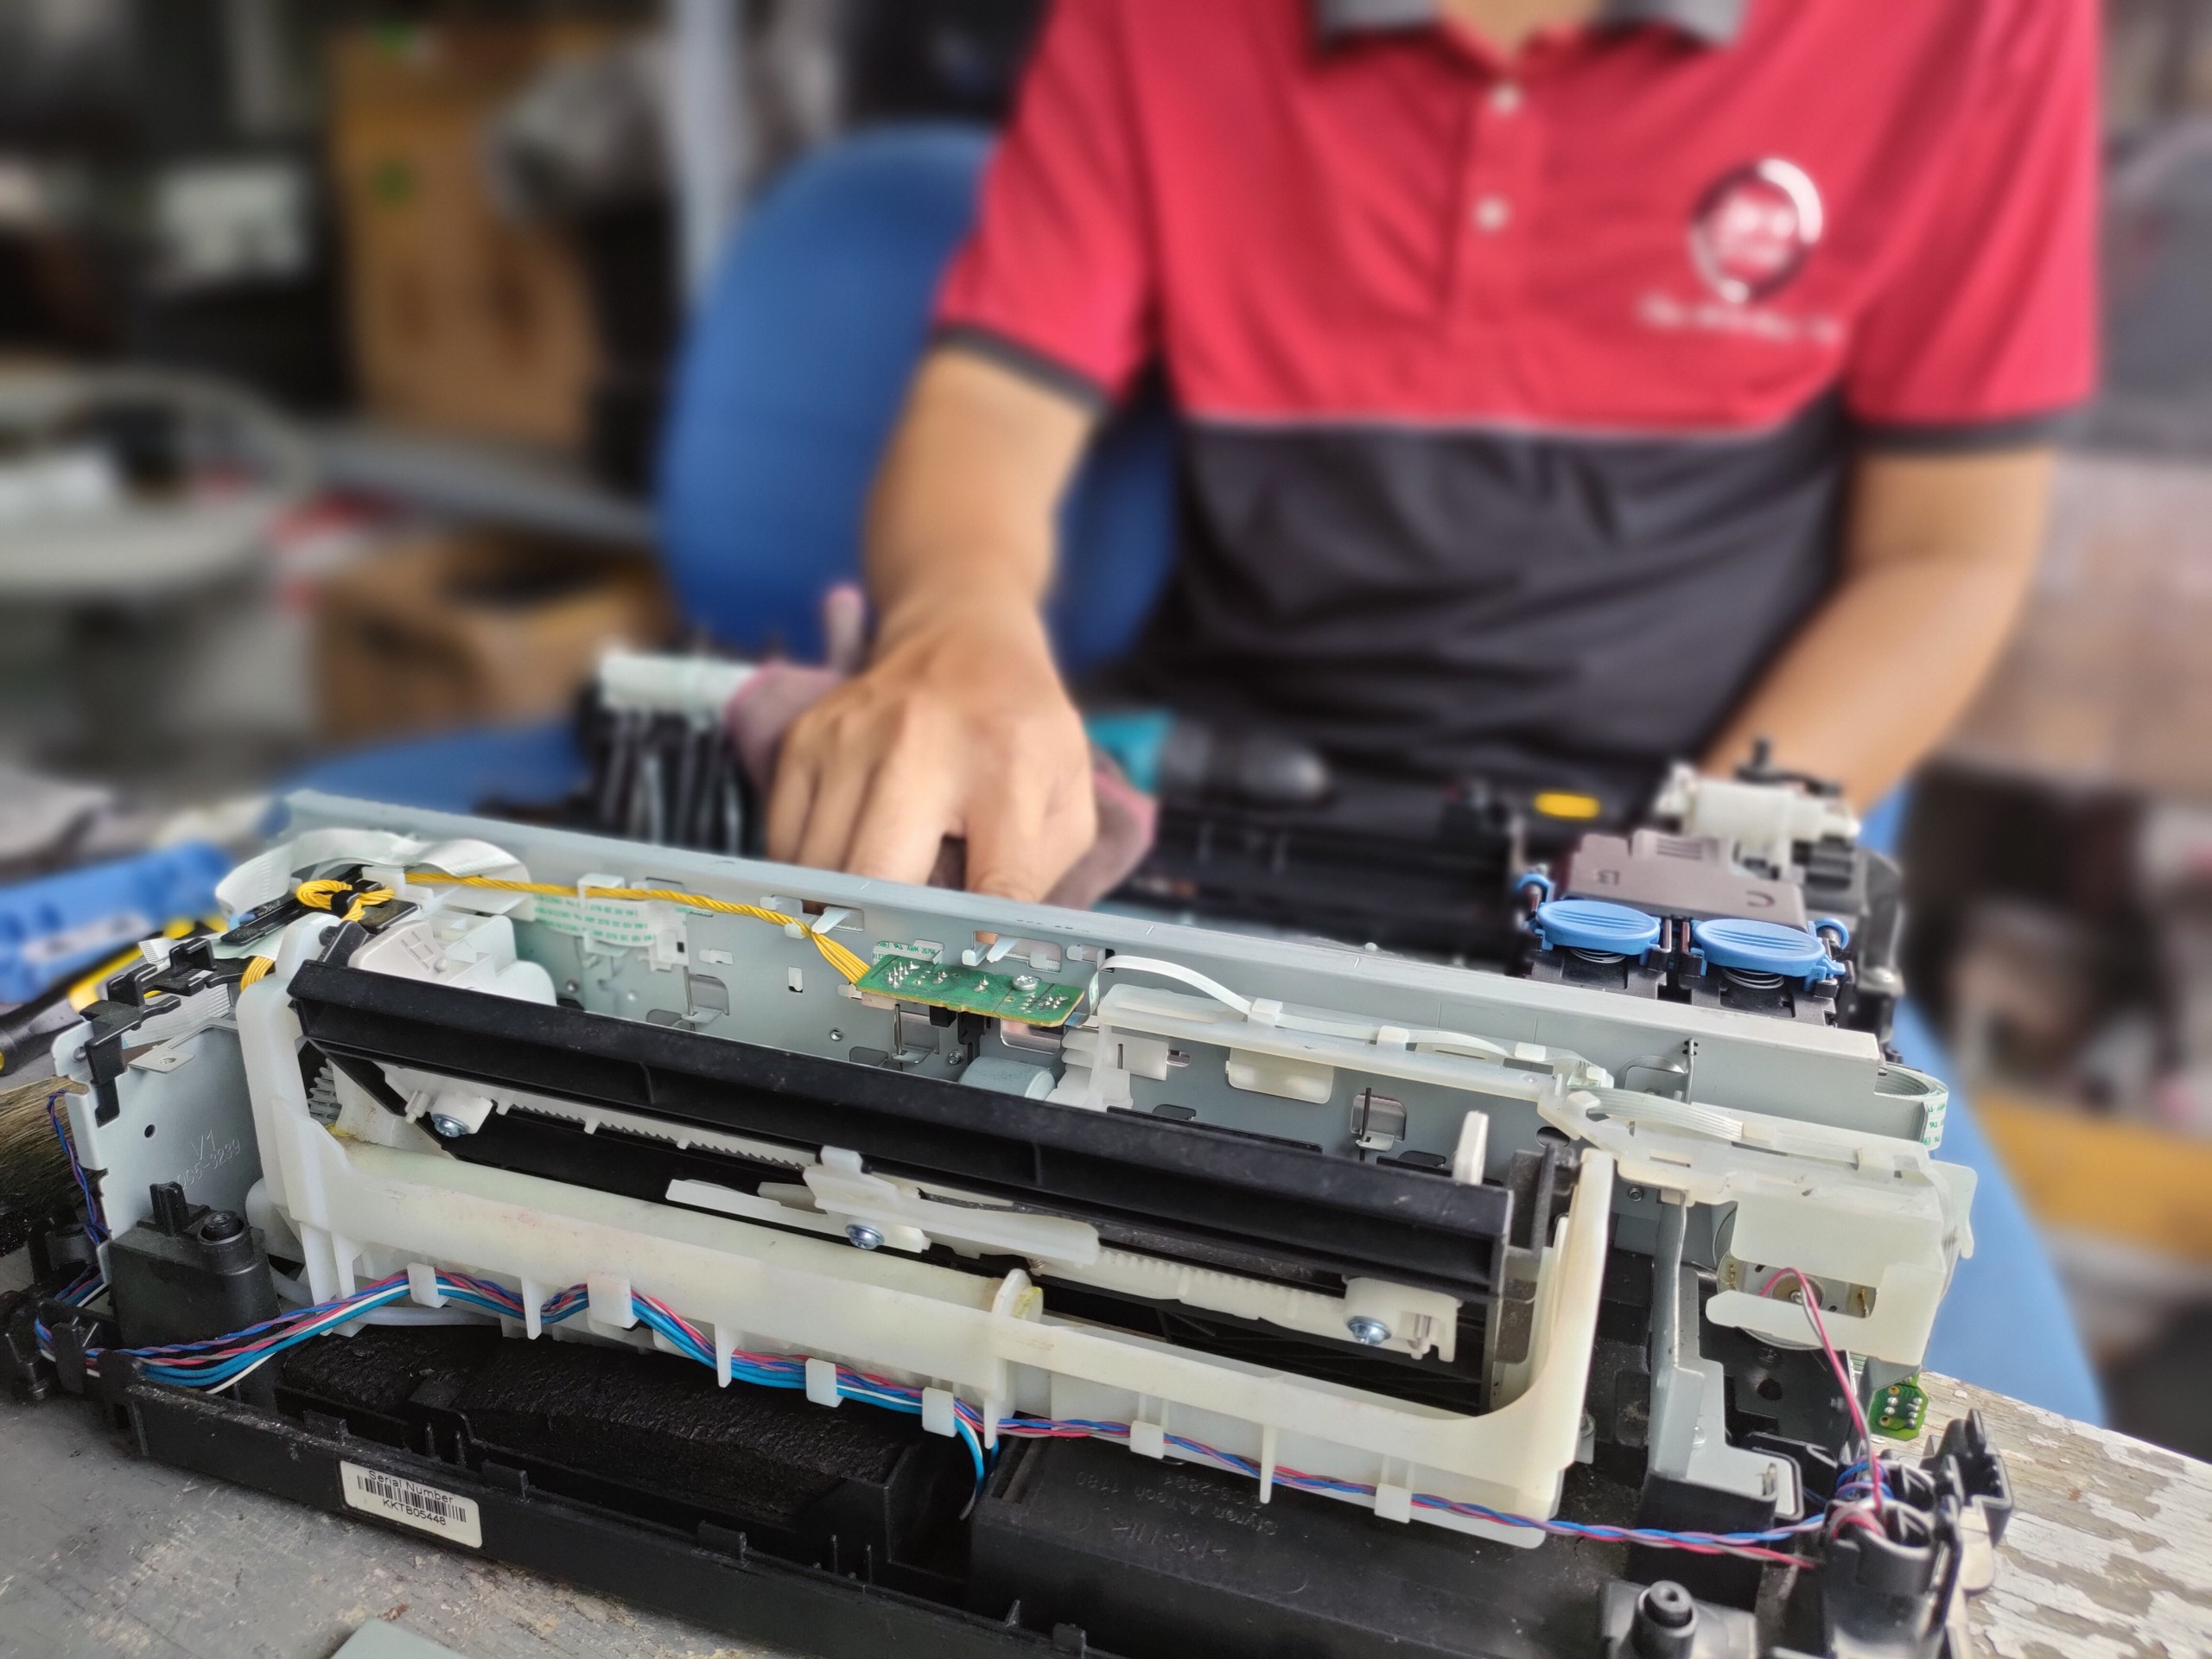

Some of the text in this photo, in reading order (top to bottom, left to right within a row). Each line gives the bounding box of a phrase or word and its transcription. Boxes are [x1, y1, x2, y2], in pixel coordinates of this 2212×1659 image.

[190, 1129, 216, 1161] V1
[368, 1470, 454, 1503] Serial Number
[383, 1497, 447, 1526] KKTB05448
